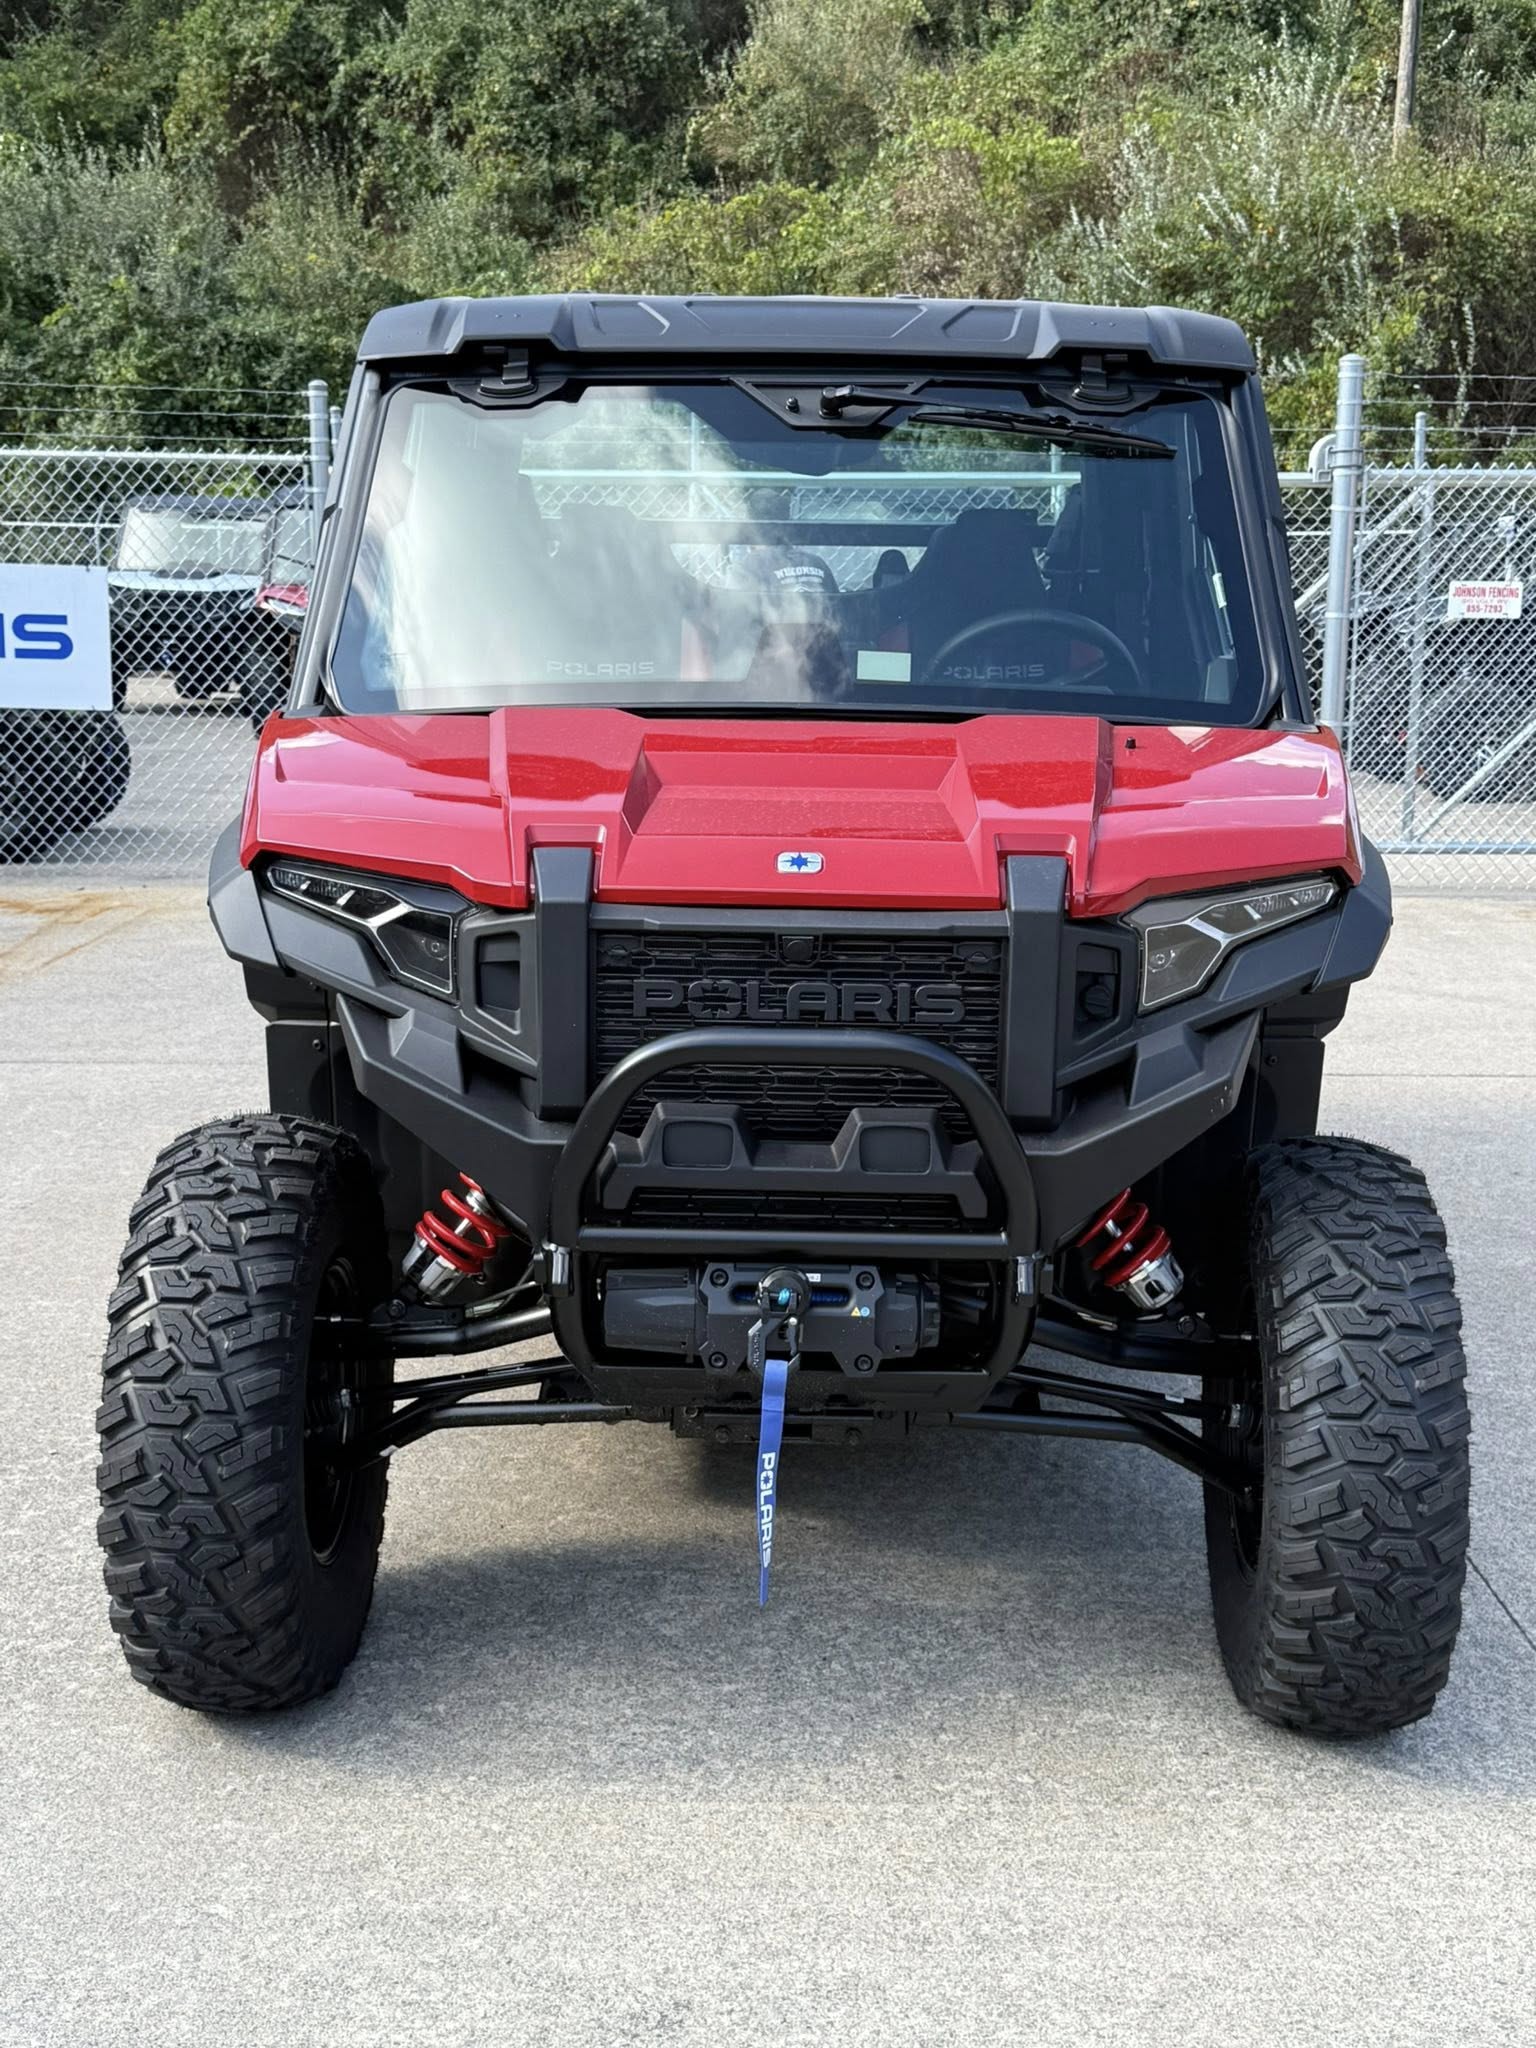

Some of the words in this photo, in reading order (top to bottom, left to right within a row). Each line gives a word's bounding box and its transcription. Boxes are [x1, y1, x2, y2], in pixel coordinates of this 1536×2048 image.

[1452, 586, 1486, 598] JOHNSON
[1488, 587, 1519, 598] FENCING
[546, 660, 655, 676] POLARIS
[632, 979, 966, 1023] POLARIS
[760, 1452, 776, 1568] POLARIS
